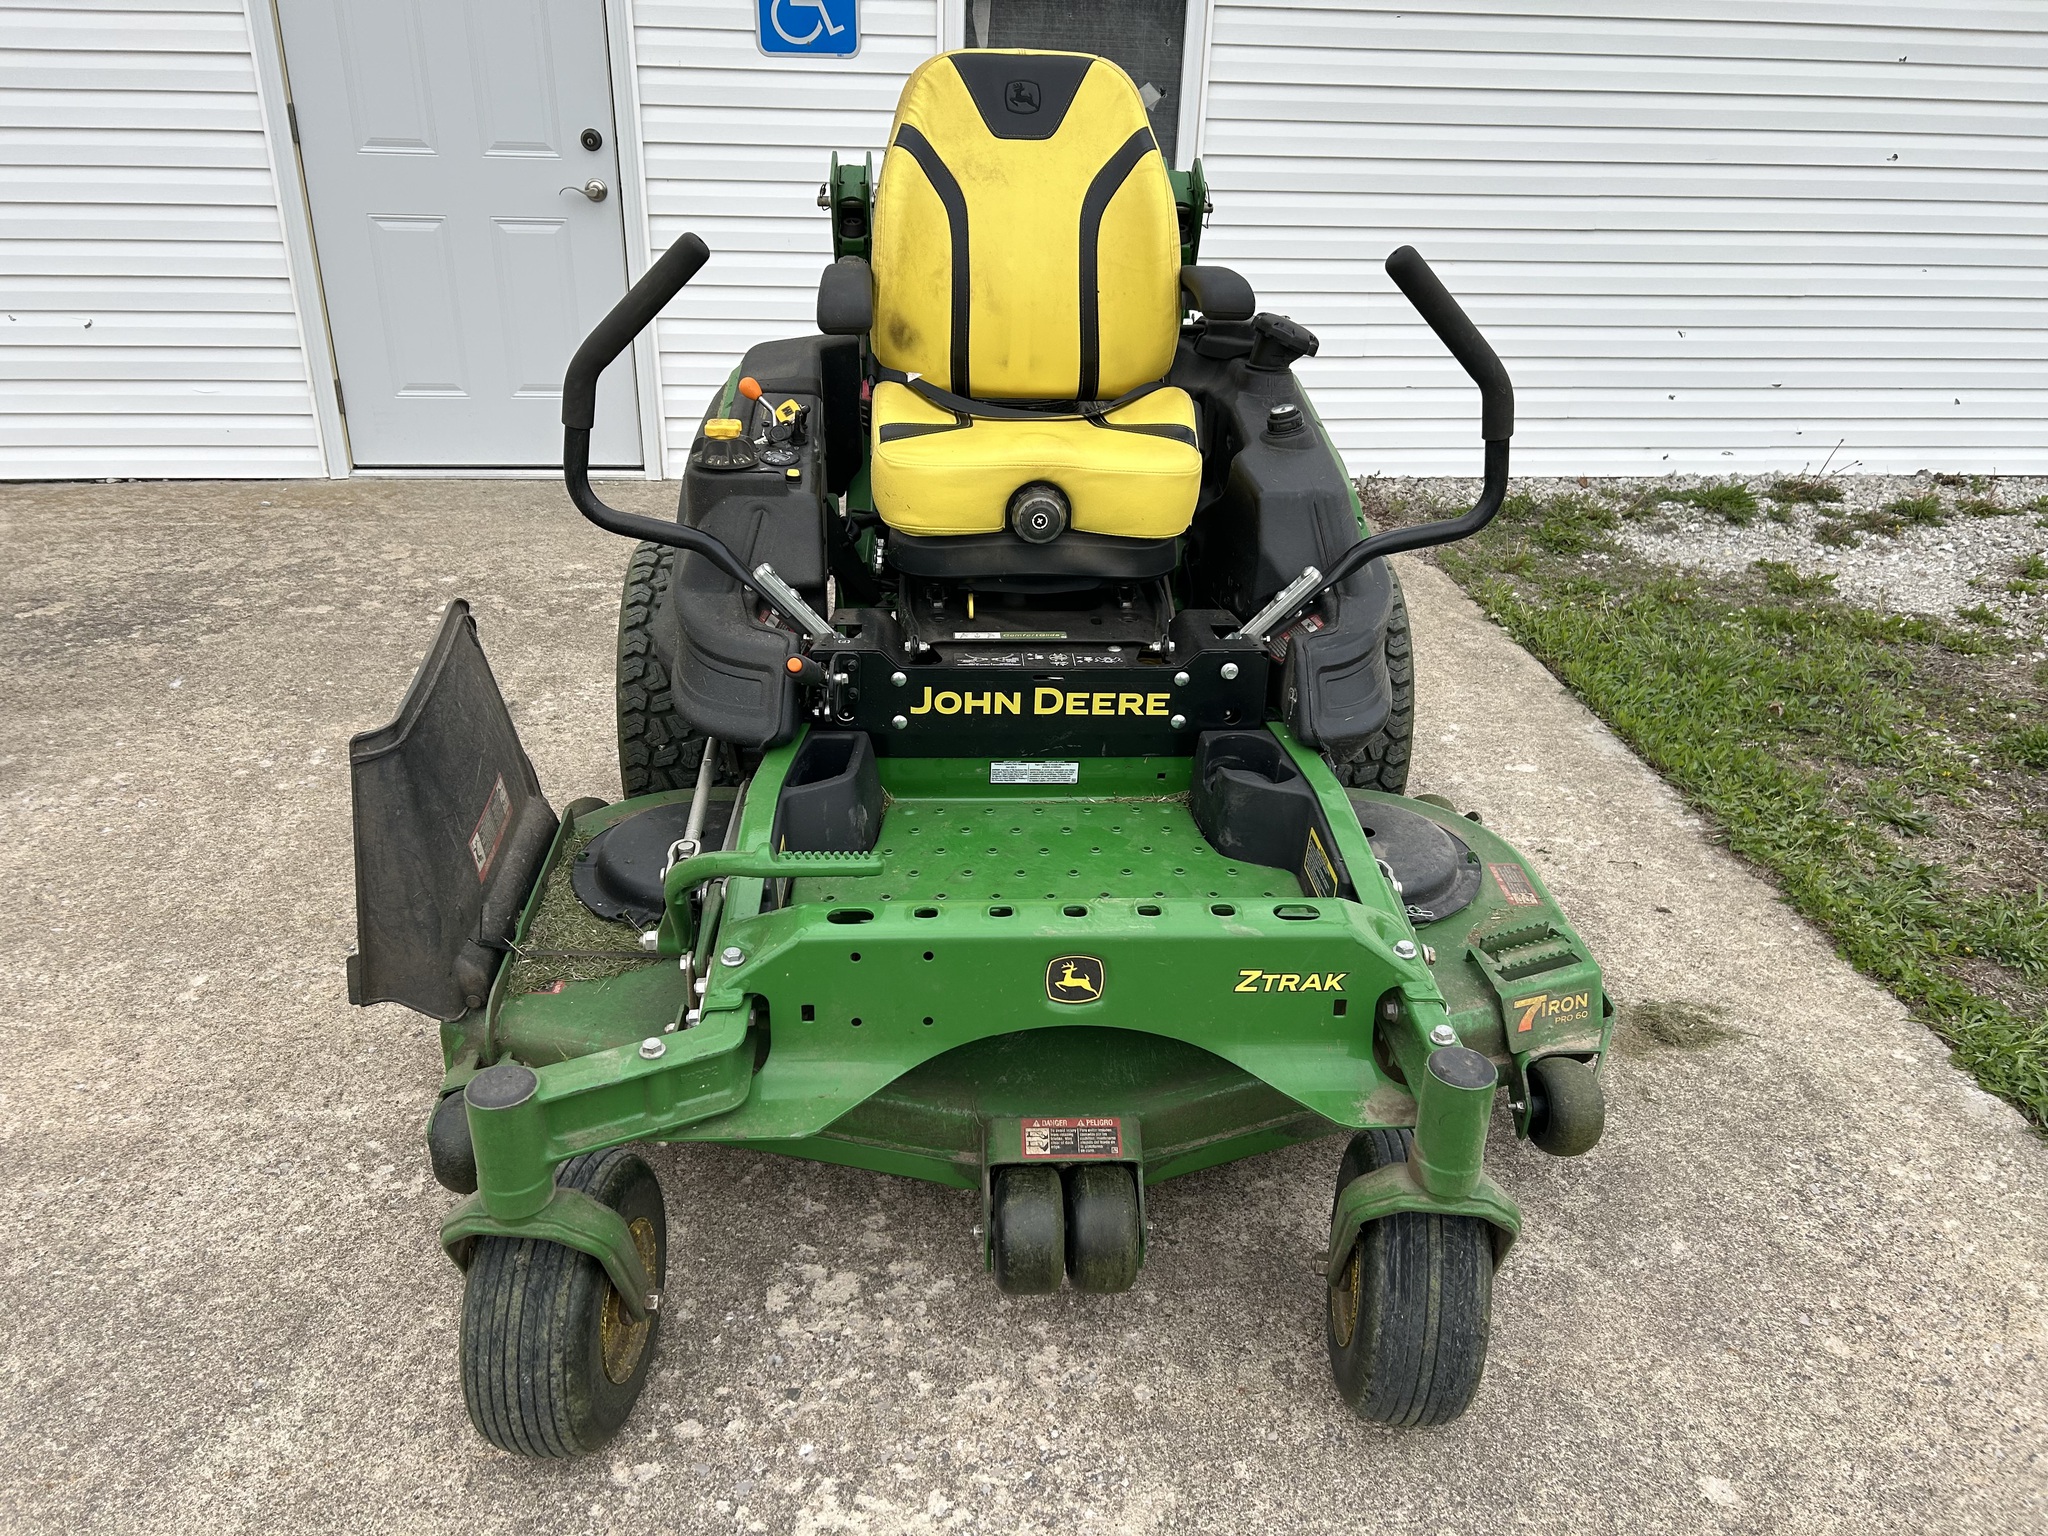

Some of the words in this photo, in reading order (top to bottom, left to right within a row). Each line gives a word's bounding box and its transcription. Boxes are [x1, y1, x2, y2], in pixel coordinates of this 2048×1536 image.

[910, 686, 1021, 715] JOHN
[1033, 687, 1171, 716] DEERE
[1234, 969, 1349, 992] ZTRAK
[1555, 1014, 1574, 1024] PRO
[1575, 1010, 1588, 1020] 60
